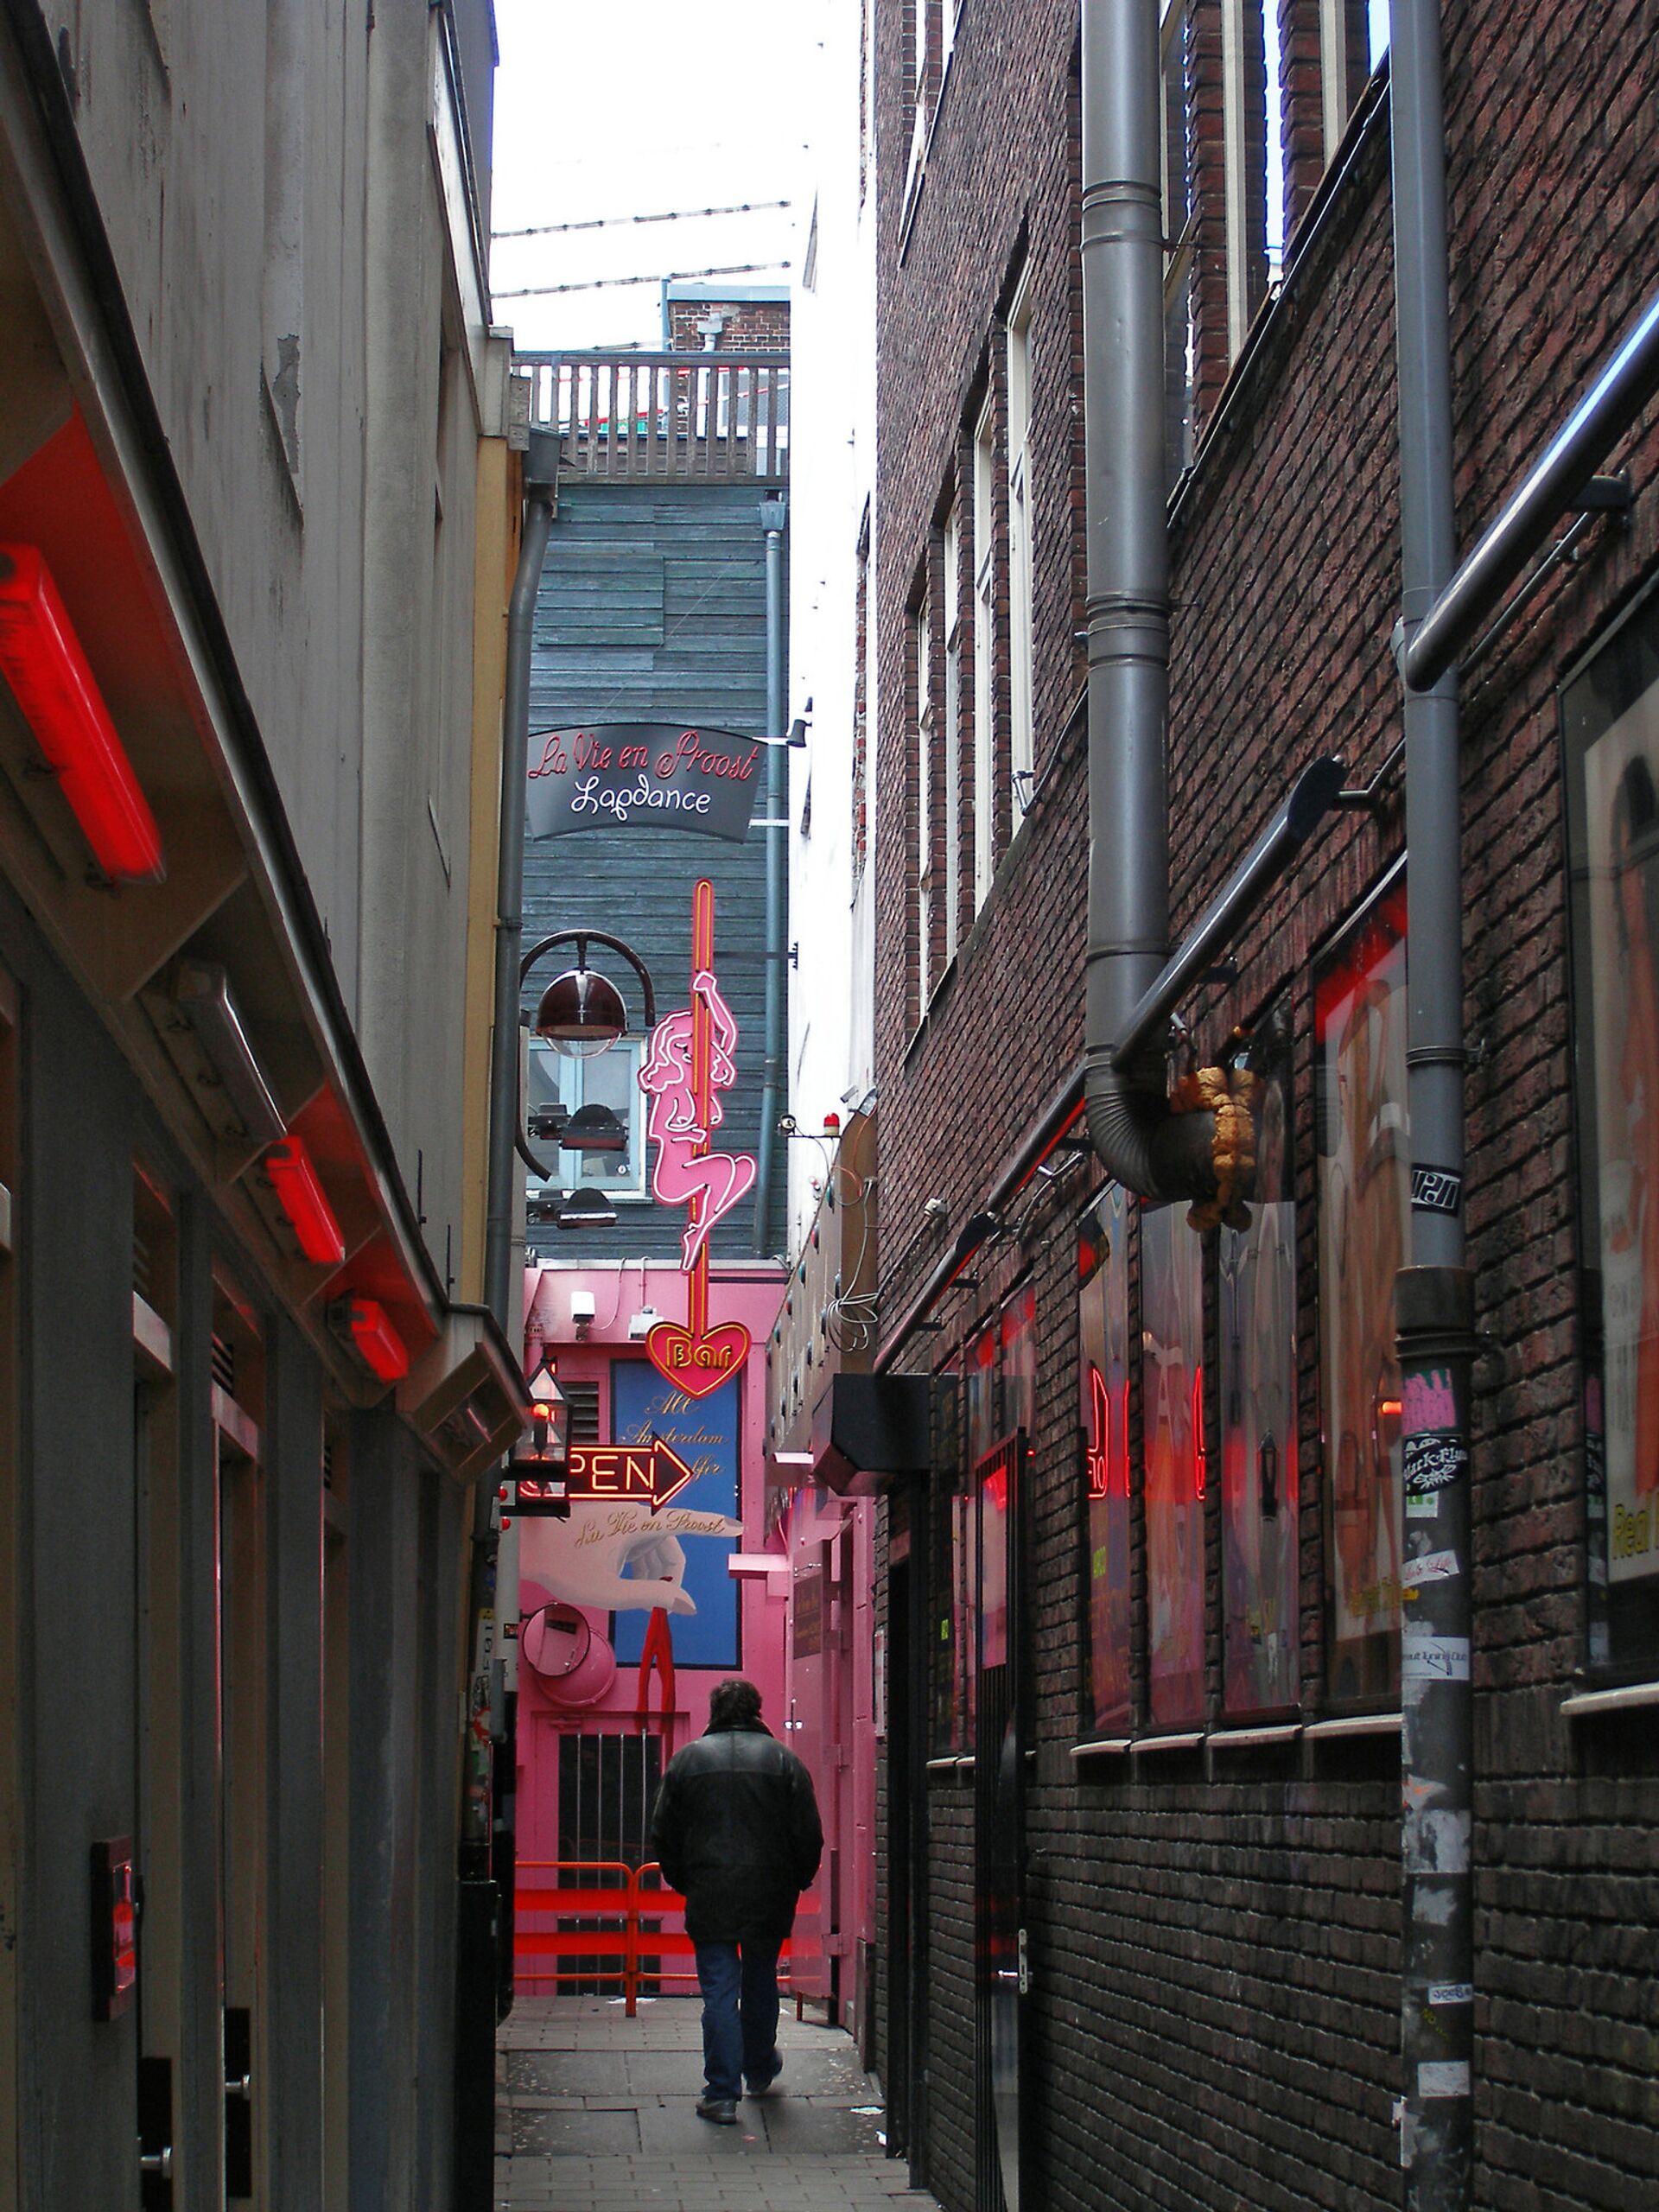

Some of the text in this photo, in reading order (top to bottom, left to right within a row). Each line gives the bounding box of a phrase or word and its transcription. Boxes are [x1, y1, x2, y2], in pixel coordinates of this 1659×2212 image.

[527, 729, 759, 781] La Vie en Proost
[570, 773, 711, 821] Lapdance
[666, 1336, 732, 1369] Bar
[526, 1453, 655, 1491] PEN
[607, 1510, 639, 1538] Vie
[666, 1510, 726, 1535] Proost
